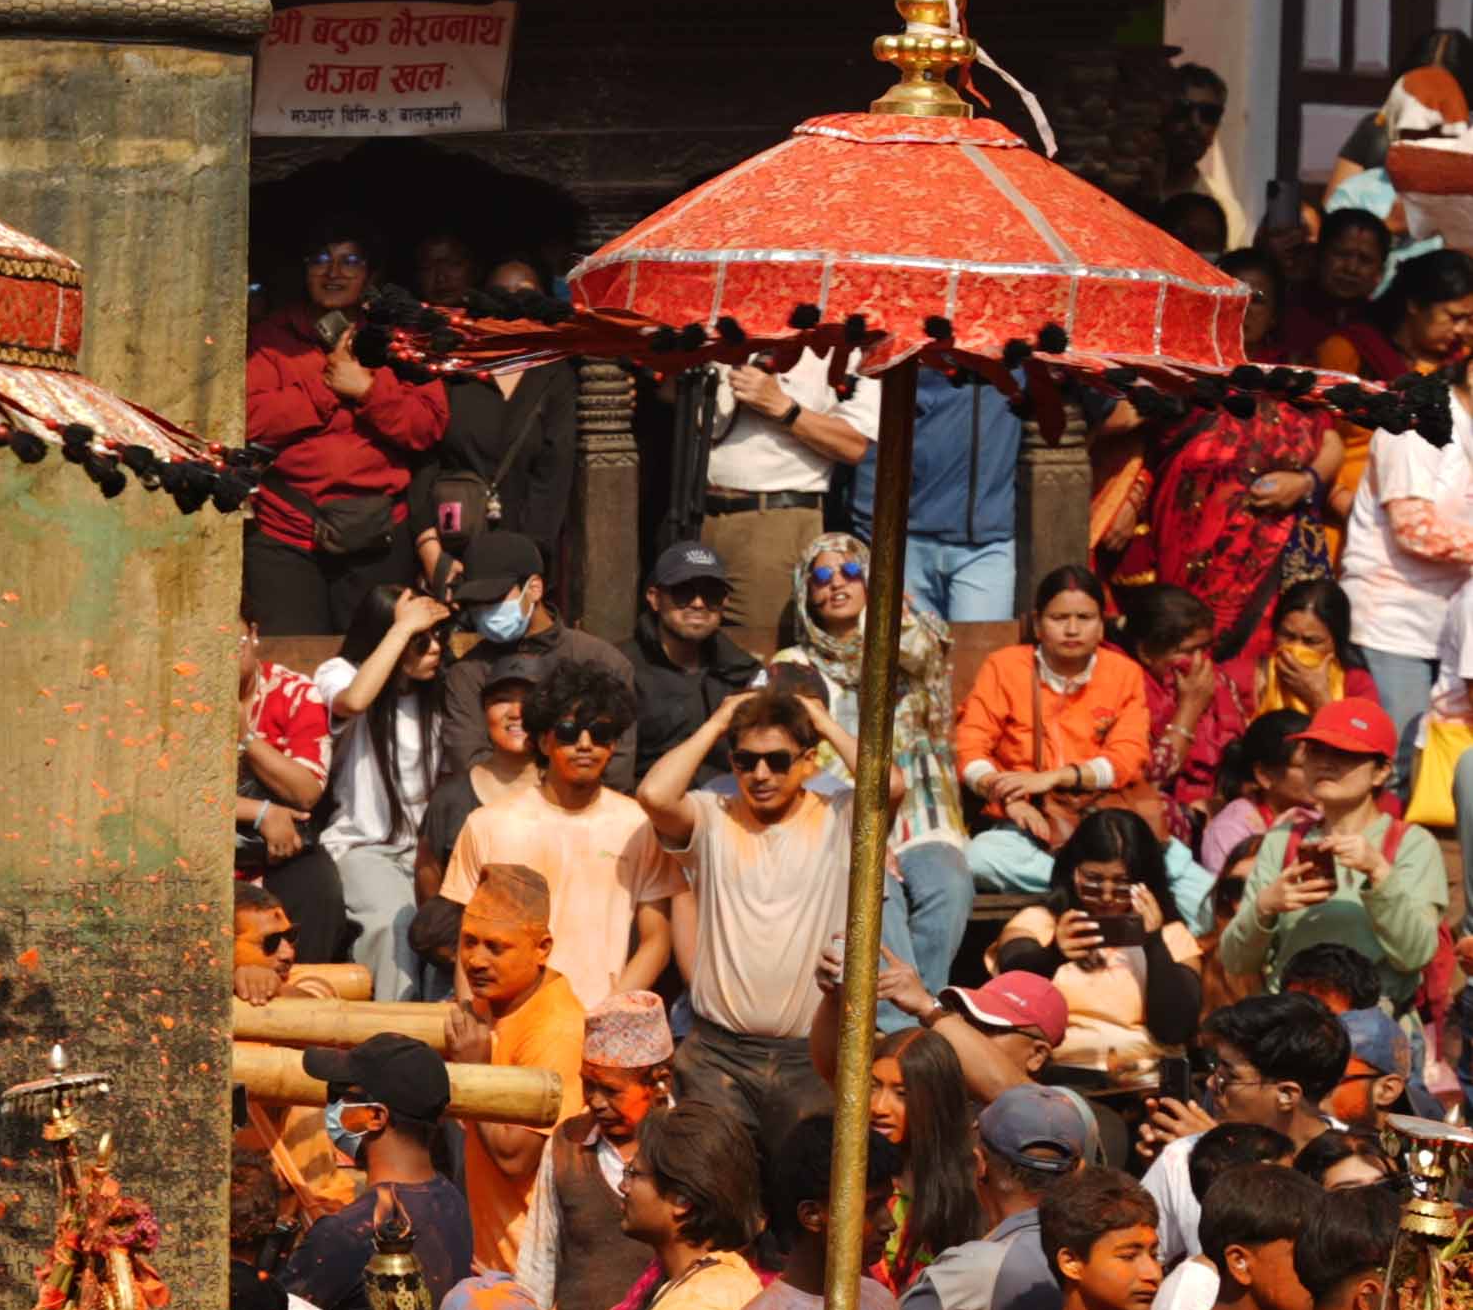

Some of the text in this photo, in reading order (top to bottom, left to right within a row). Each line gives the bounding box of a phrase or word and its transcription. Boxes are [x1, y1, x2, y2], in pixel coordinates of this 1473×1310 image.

[267, 8, 506, 54] श्री बटुक भैरवनाथ
[305, 63, 382, 94] भजन
